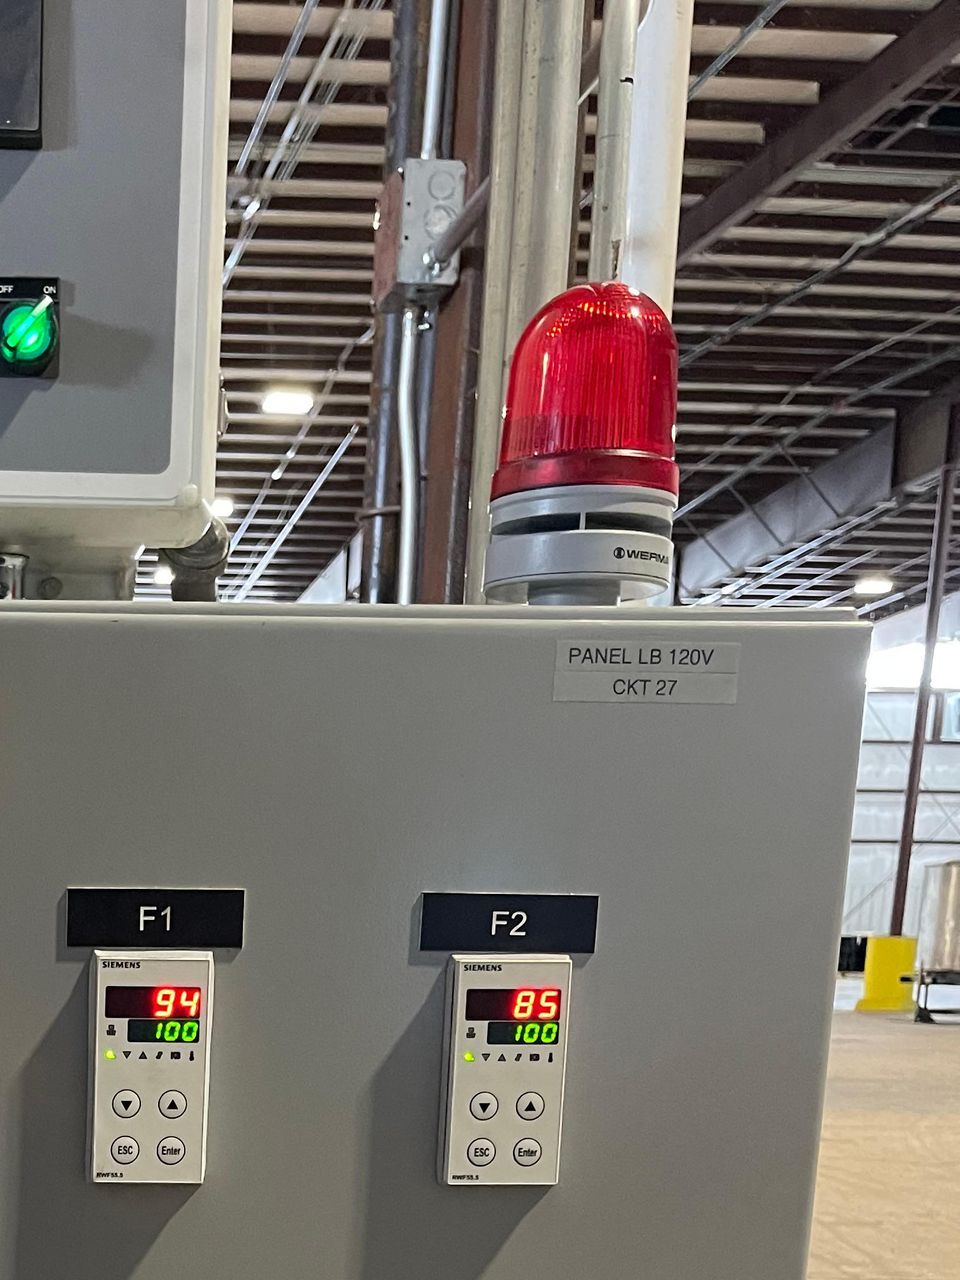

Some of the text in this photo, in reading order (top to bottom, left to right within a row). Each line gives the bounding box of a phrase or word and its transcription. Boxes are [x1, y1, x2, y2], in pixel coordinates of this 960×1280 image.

[43, 285, 57, 294] ON
[568, 648, 715, 665] PANEL LB 120V
[613, 679, 678, 696] CKT 27
[139, 906, 172, 931] F1
[491, 911, 528, 936] F2
[102, 961, 141, 969] SIEMENS
[463, 964, 503, 972] SIEMENS
[154, 989, 200, 1017] 94
[513, 991, 559, 1019] 85
[156, 1021, 199, 1042] 100
[515, 1023, 558, 1044] 100
[117, 1145, 134, 1155] ESC
[161, 1146, 181, 1156] Enter
[473, 1147, 490, 1157] ESC
[518, 1147, 538, 1158] Enter
